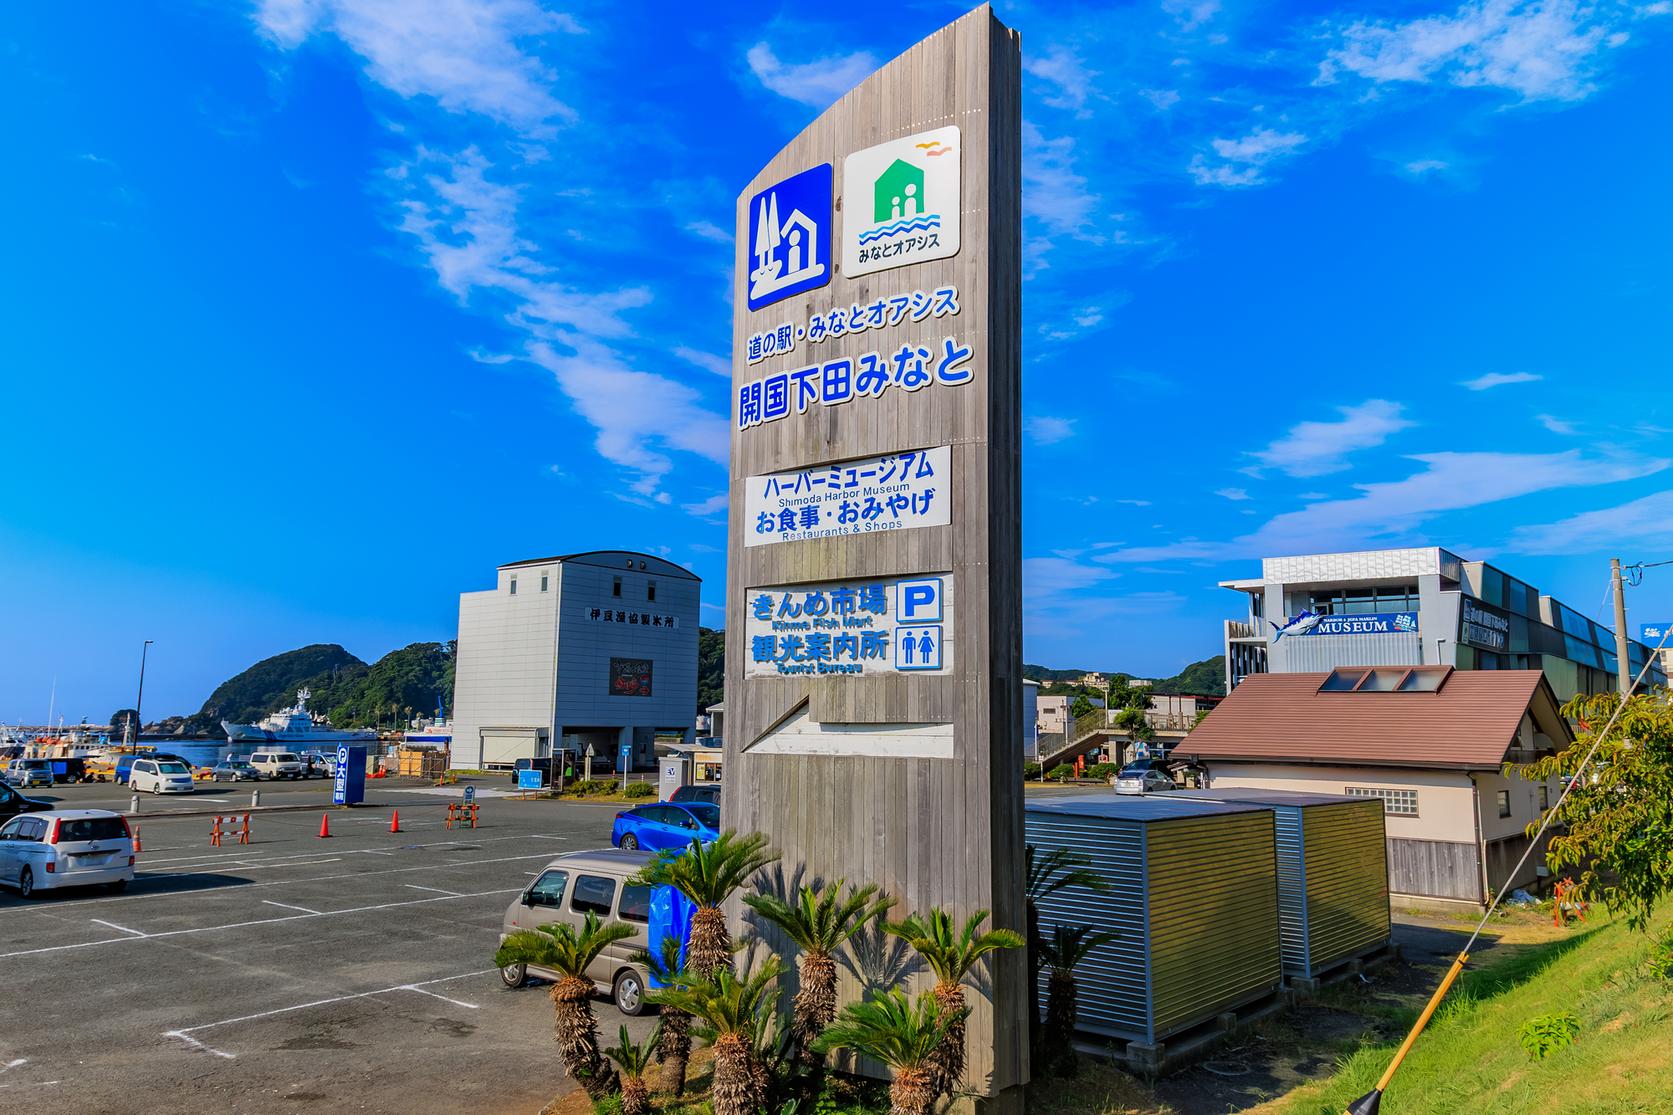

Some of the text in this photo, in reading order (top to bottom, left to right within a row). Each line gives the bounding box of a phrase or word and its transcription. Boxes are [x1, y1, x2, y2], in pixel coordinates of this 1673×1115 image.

[858, 233, 940, 263] みなとオアシス
[748, 288, 959, 361] 道の駅・みなとオアシス
[739, 340, 970, 427] 開国下田みなと
[763, 451, 935, 499] ハーバーミュージアム
[755, 487, 936, 535] お食事・おみやげ
[778, 483, 910, 507] Shimoda Harbor Museum
[782, 520, 903, 541] Restaurants & Shops
[753, 584, 888, 620] きんめ市場
[904, 585, 935, 617] P
[772, 615, 873, 631] Kinme Fish Mart
[1318, 621, 1388, 633] MUSEUM
[752, 630, 889, 663] 観光案内所
[775, 661, 863, 675] Tourist Bureau
